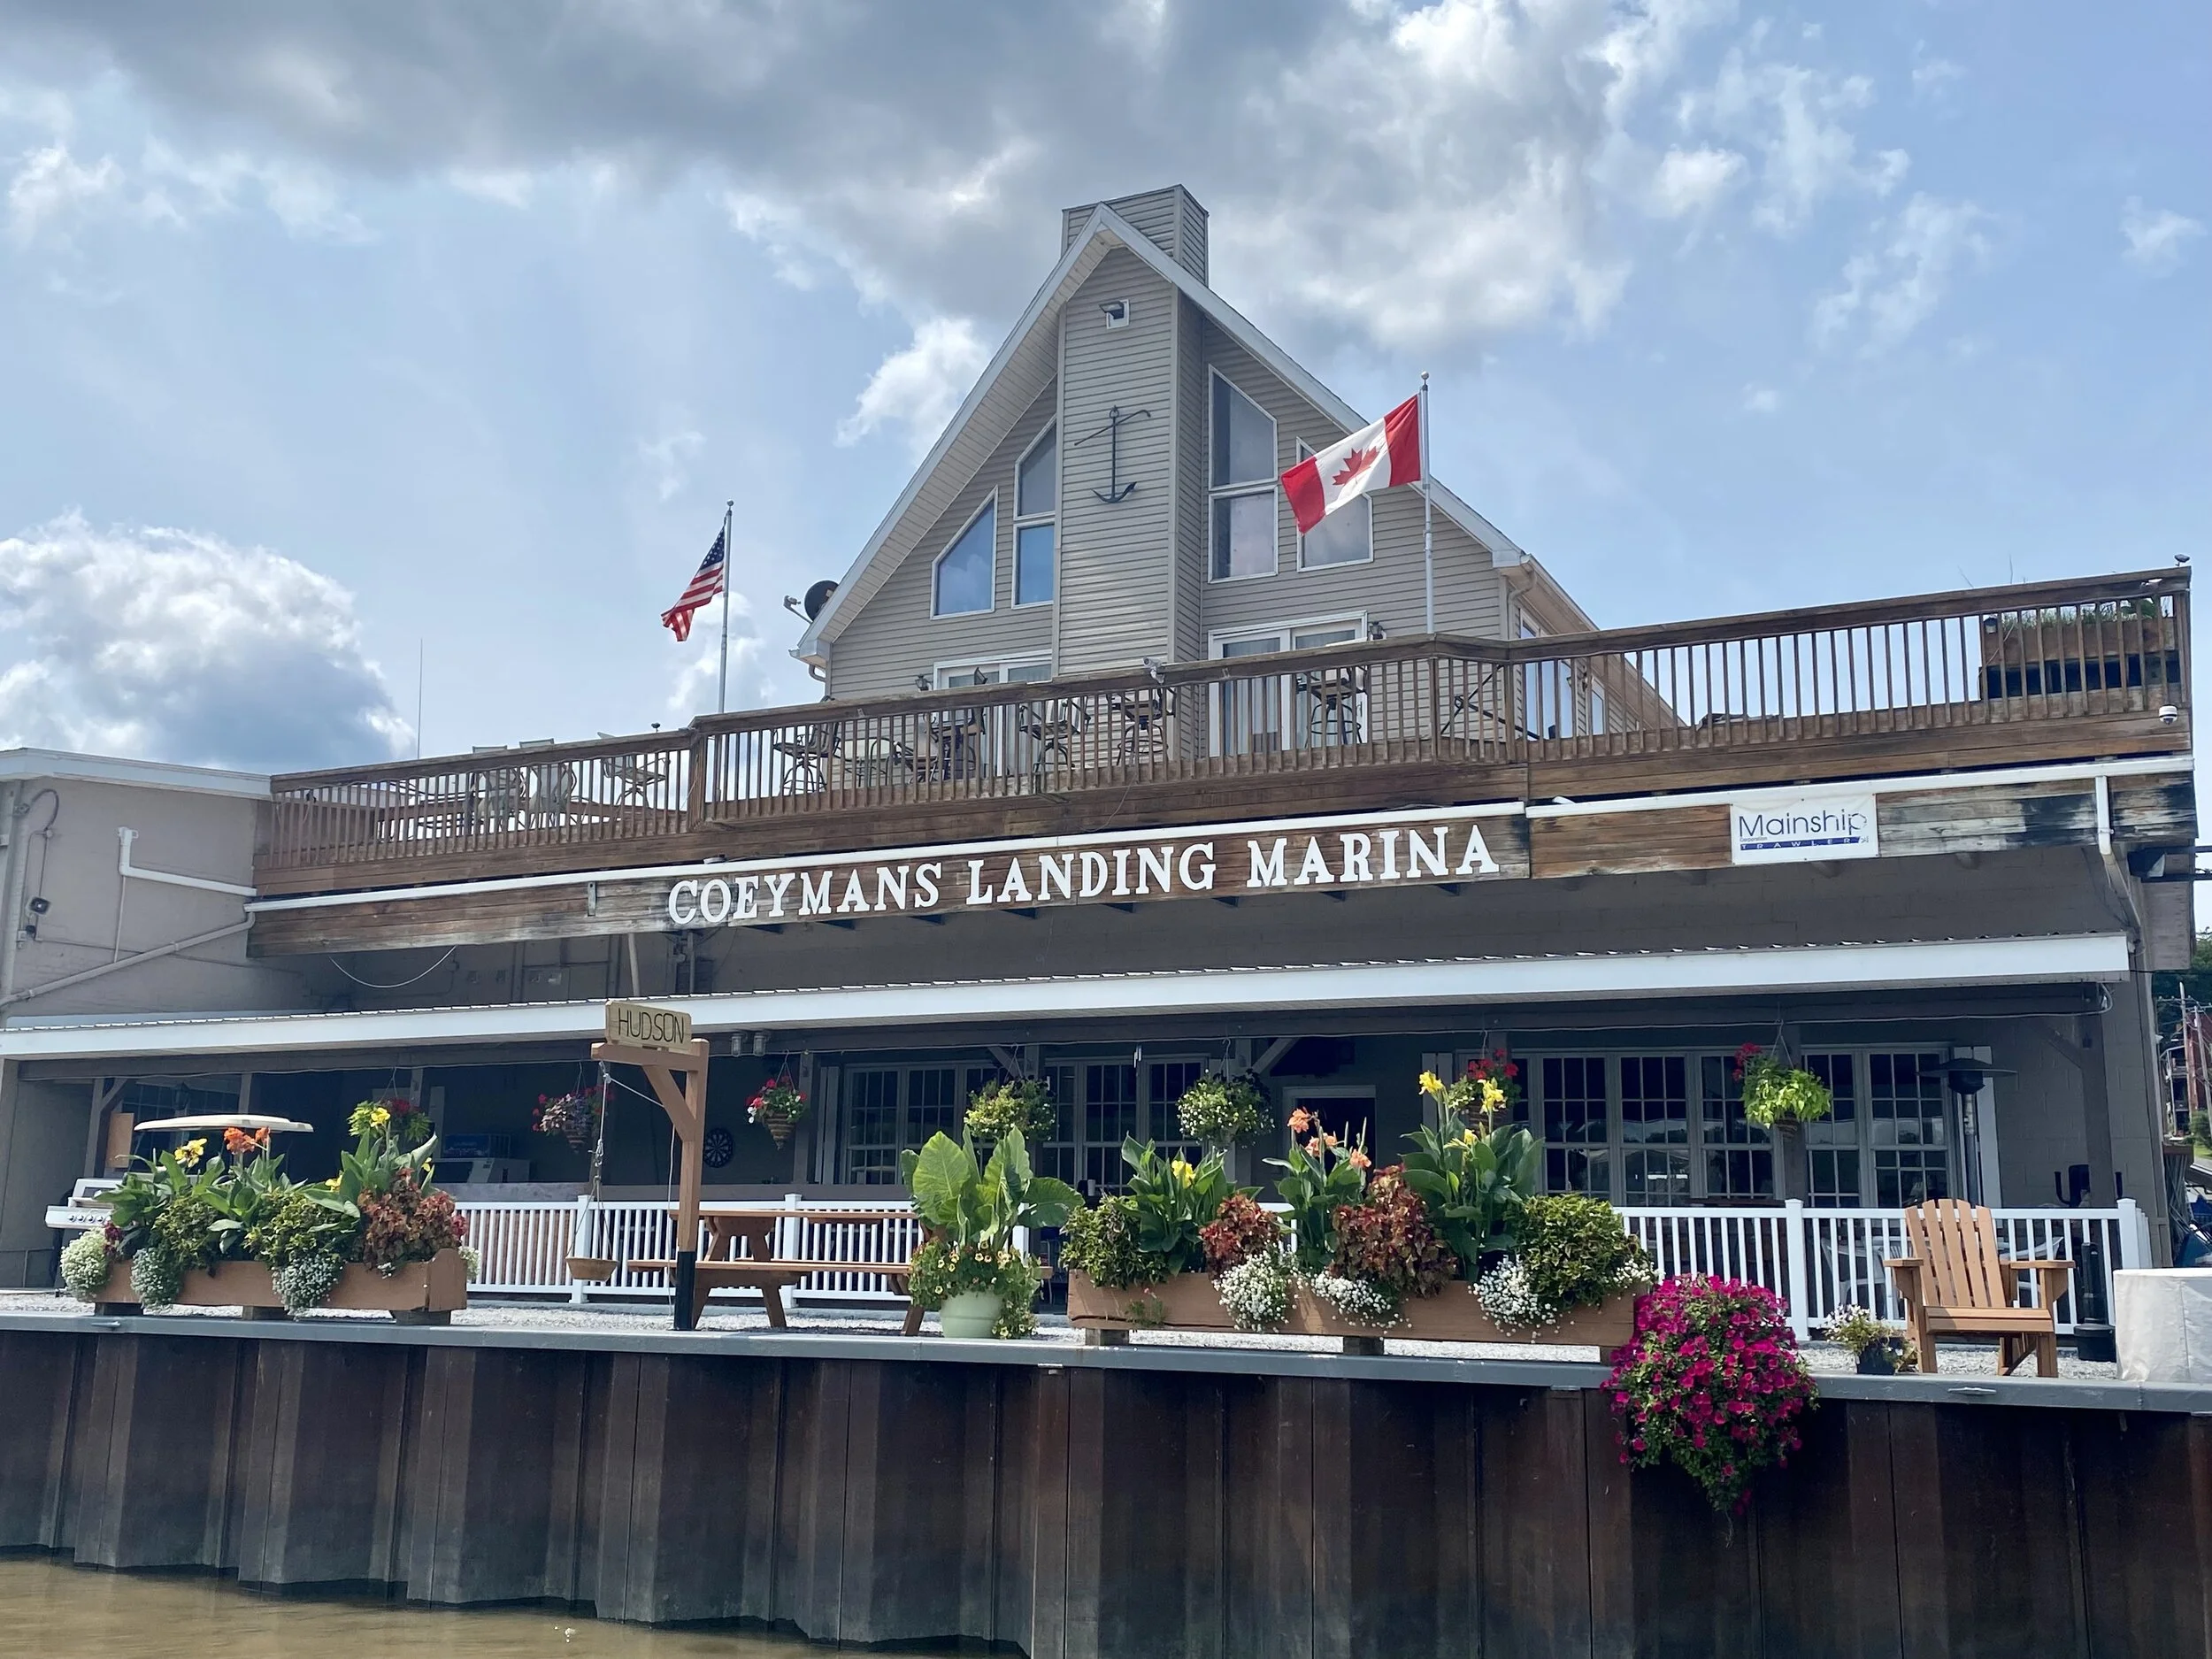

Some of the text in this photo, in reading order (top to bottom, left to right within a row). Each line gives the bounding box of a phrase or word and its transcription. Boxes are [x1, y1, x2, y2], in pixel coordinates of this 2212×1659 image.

[1739, 809, 1867, 837] Mainship
[667, 824, 1501, 926] COEYMANS LANDING MARINA
[618, 1007, 685, 1044] HUDSON
